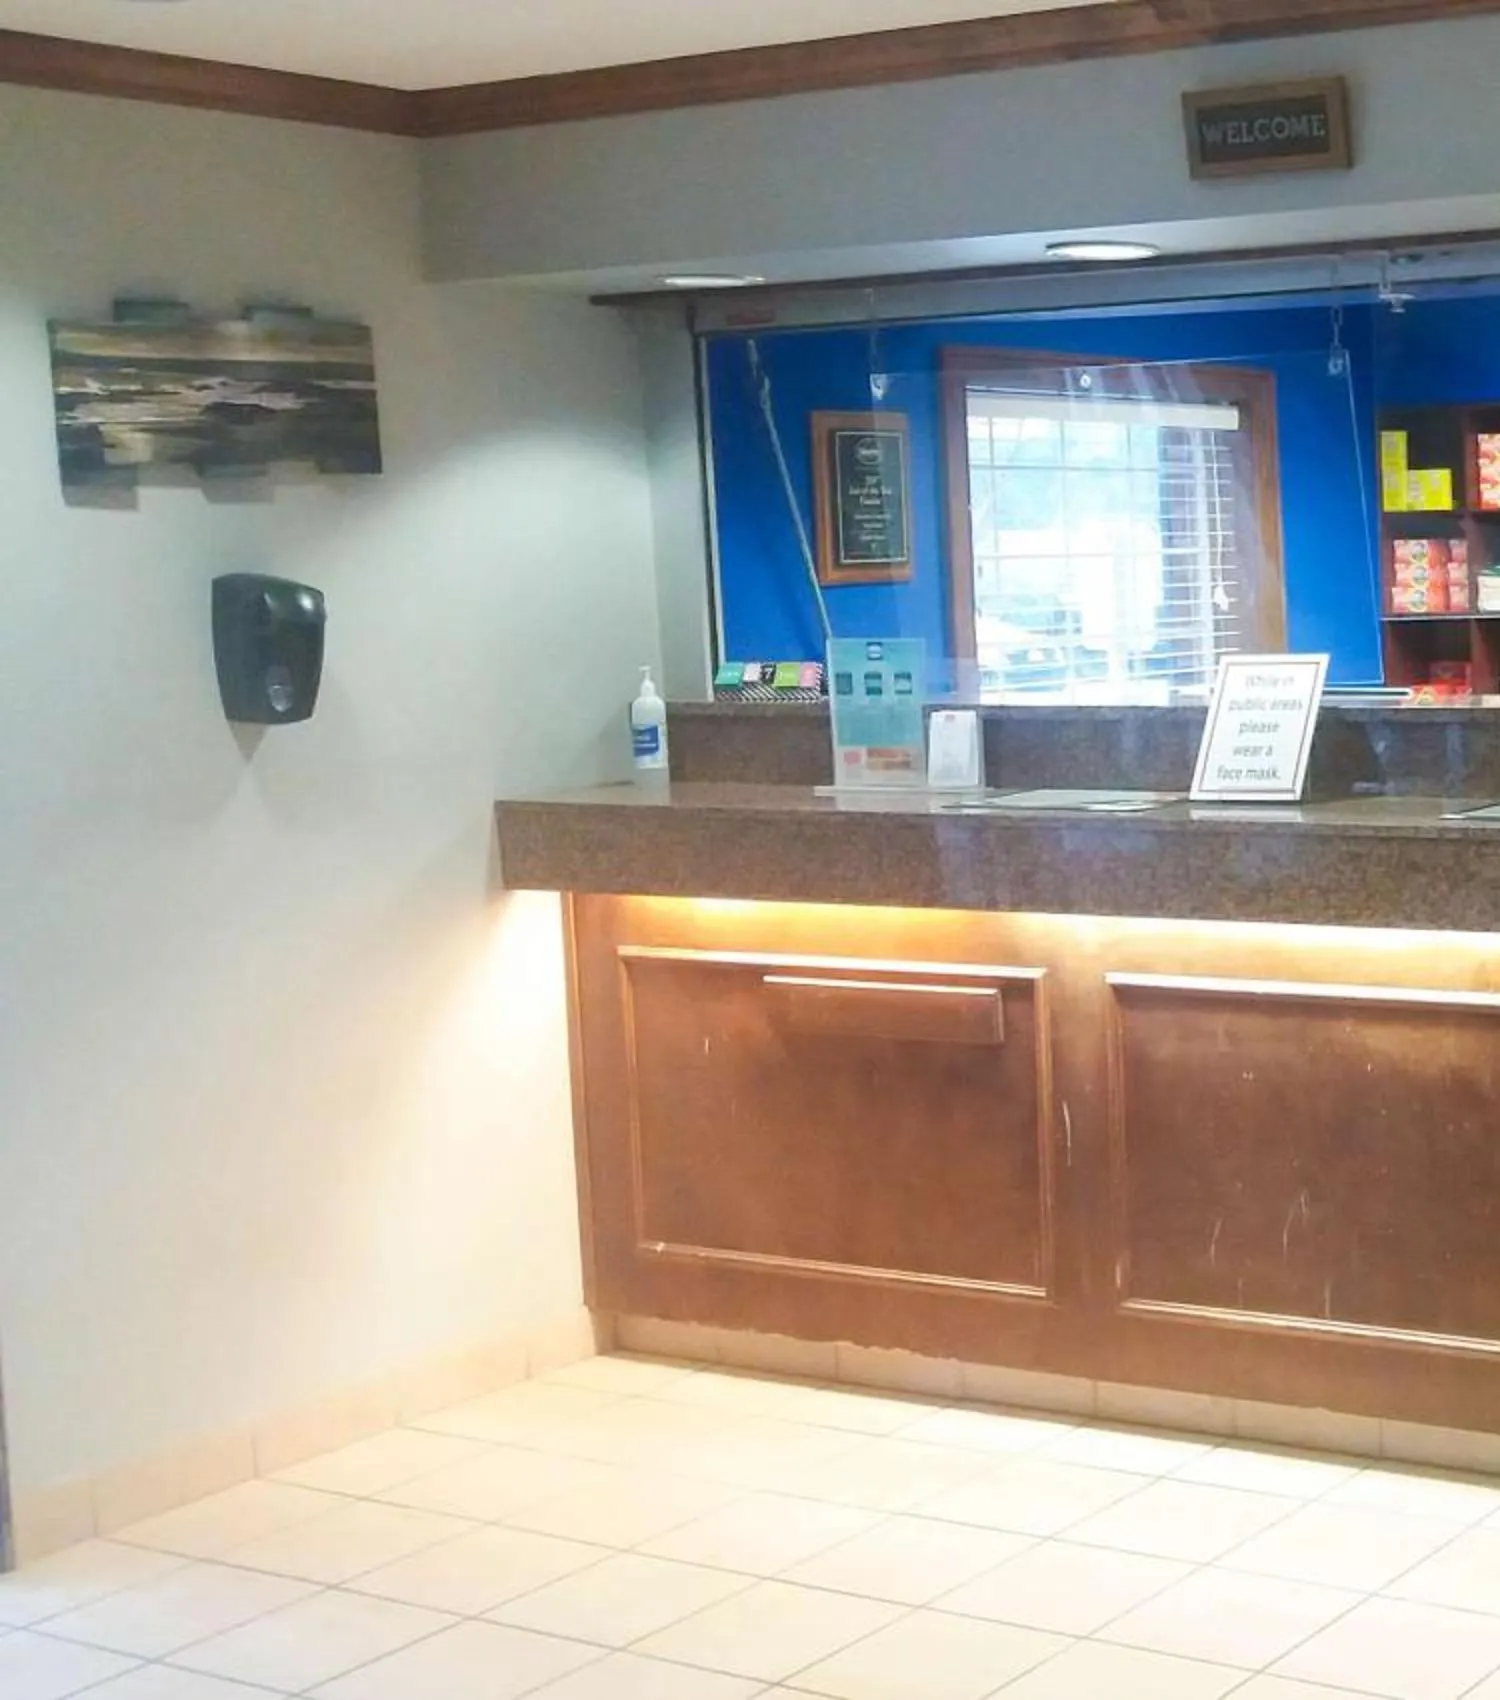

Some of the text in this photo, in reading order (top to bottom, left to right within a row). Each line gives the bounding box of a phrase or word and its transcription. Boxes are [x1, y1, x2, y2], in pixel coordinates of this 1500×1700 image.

[1201, 114, 1327, 145] WELCOME
[1228, 697, 1304, 712] public areas
[1237, 719, 1281, 737] please
[1232, 745, 1264, 758] wear
[1217, 764, 1243, 782] face
